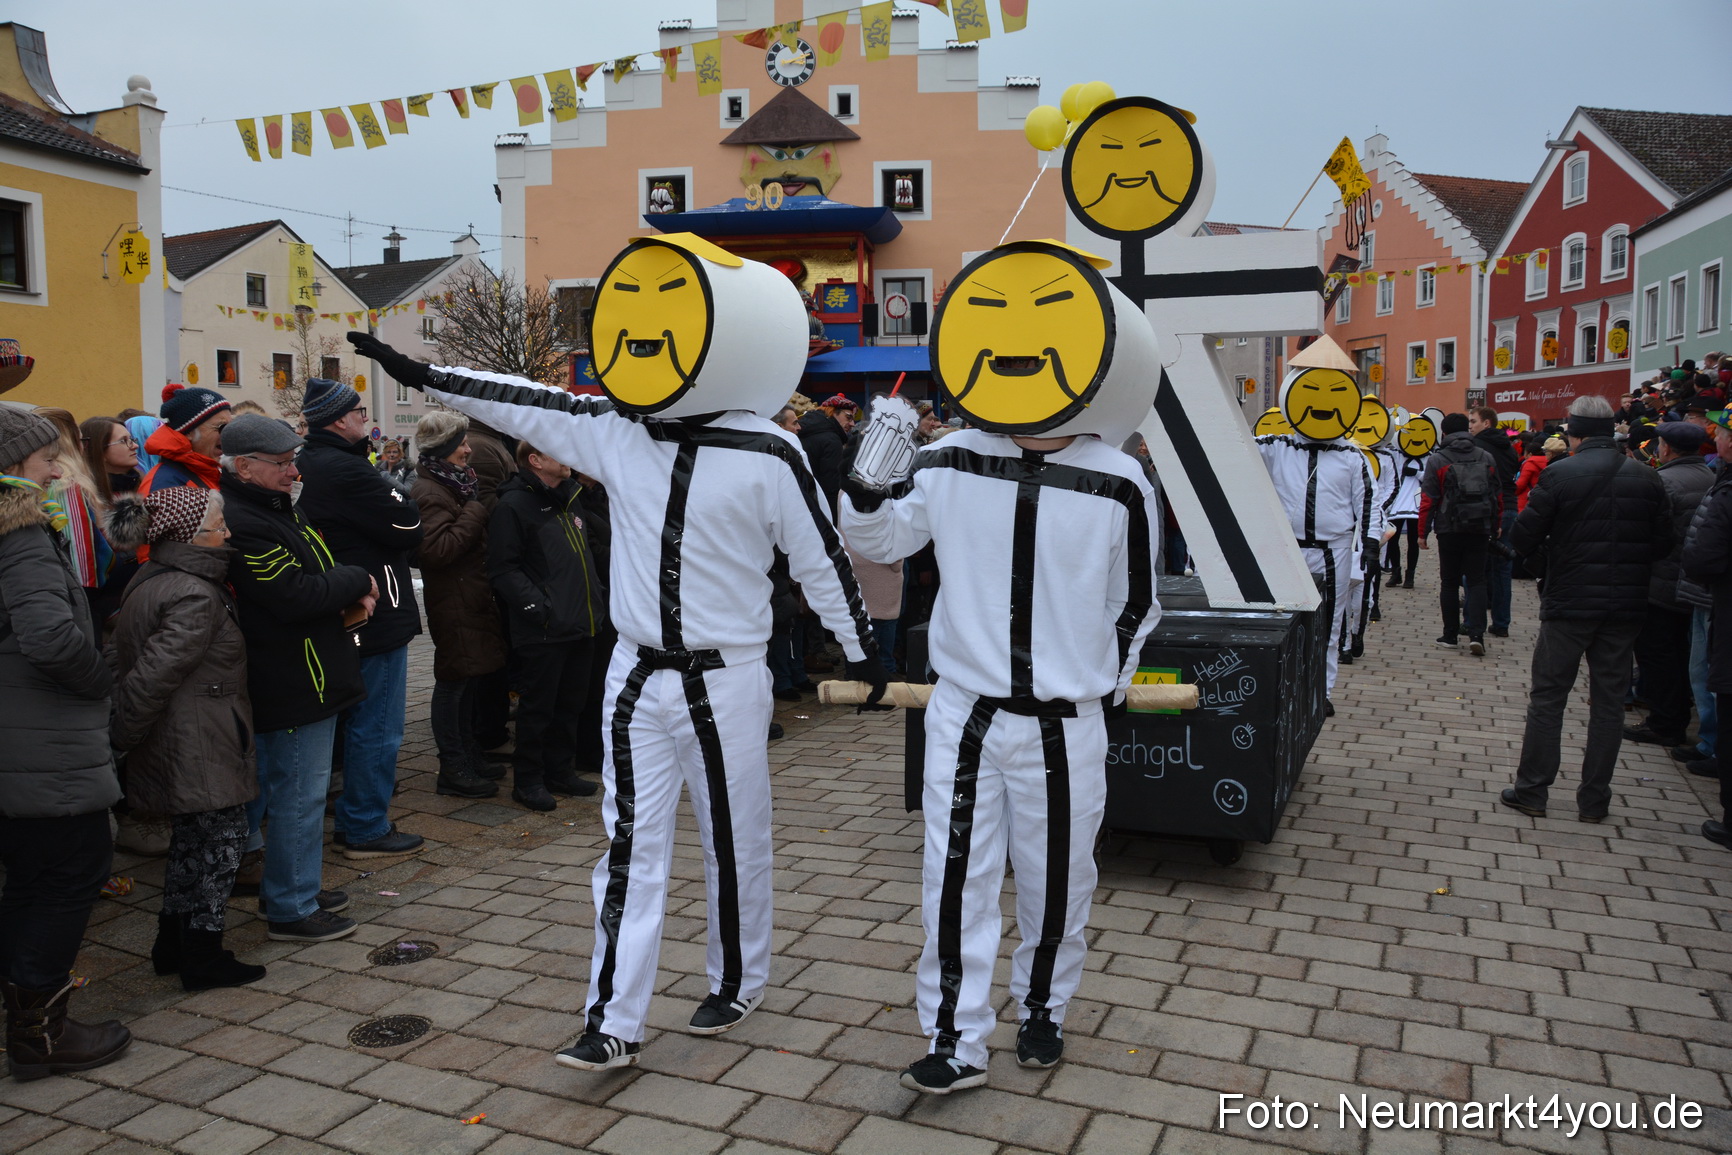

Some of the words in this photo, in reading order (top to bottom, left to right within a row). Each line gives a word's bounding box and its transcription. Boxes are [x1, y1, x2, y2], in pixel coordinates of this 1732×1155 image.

[745, 182, 784, 210] 90
[1467, 390, 1485, 400] CAFÉ
[1193, 648, 1241, 682] Hecht
[1198, 682, 1245, 708] Helau
